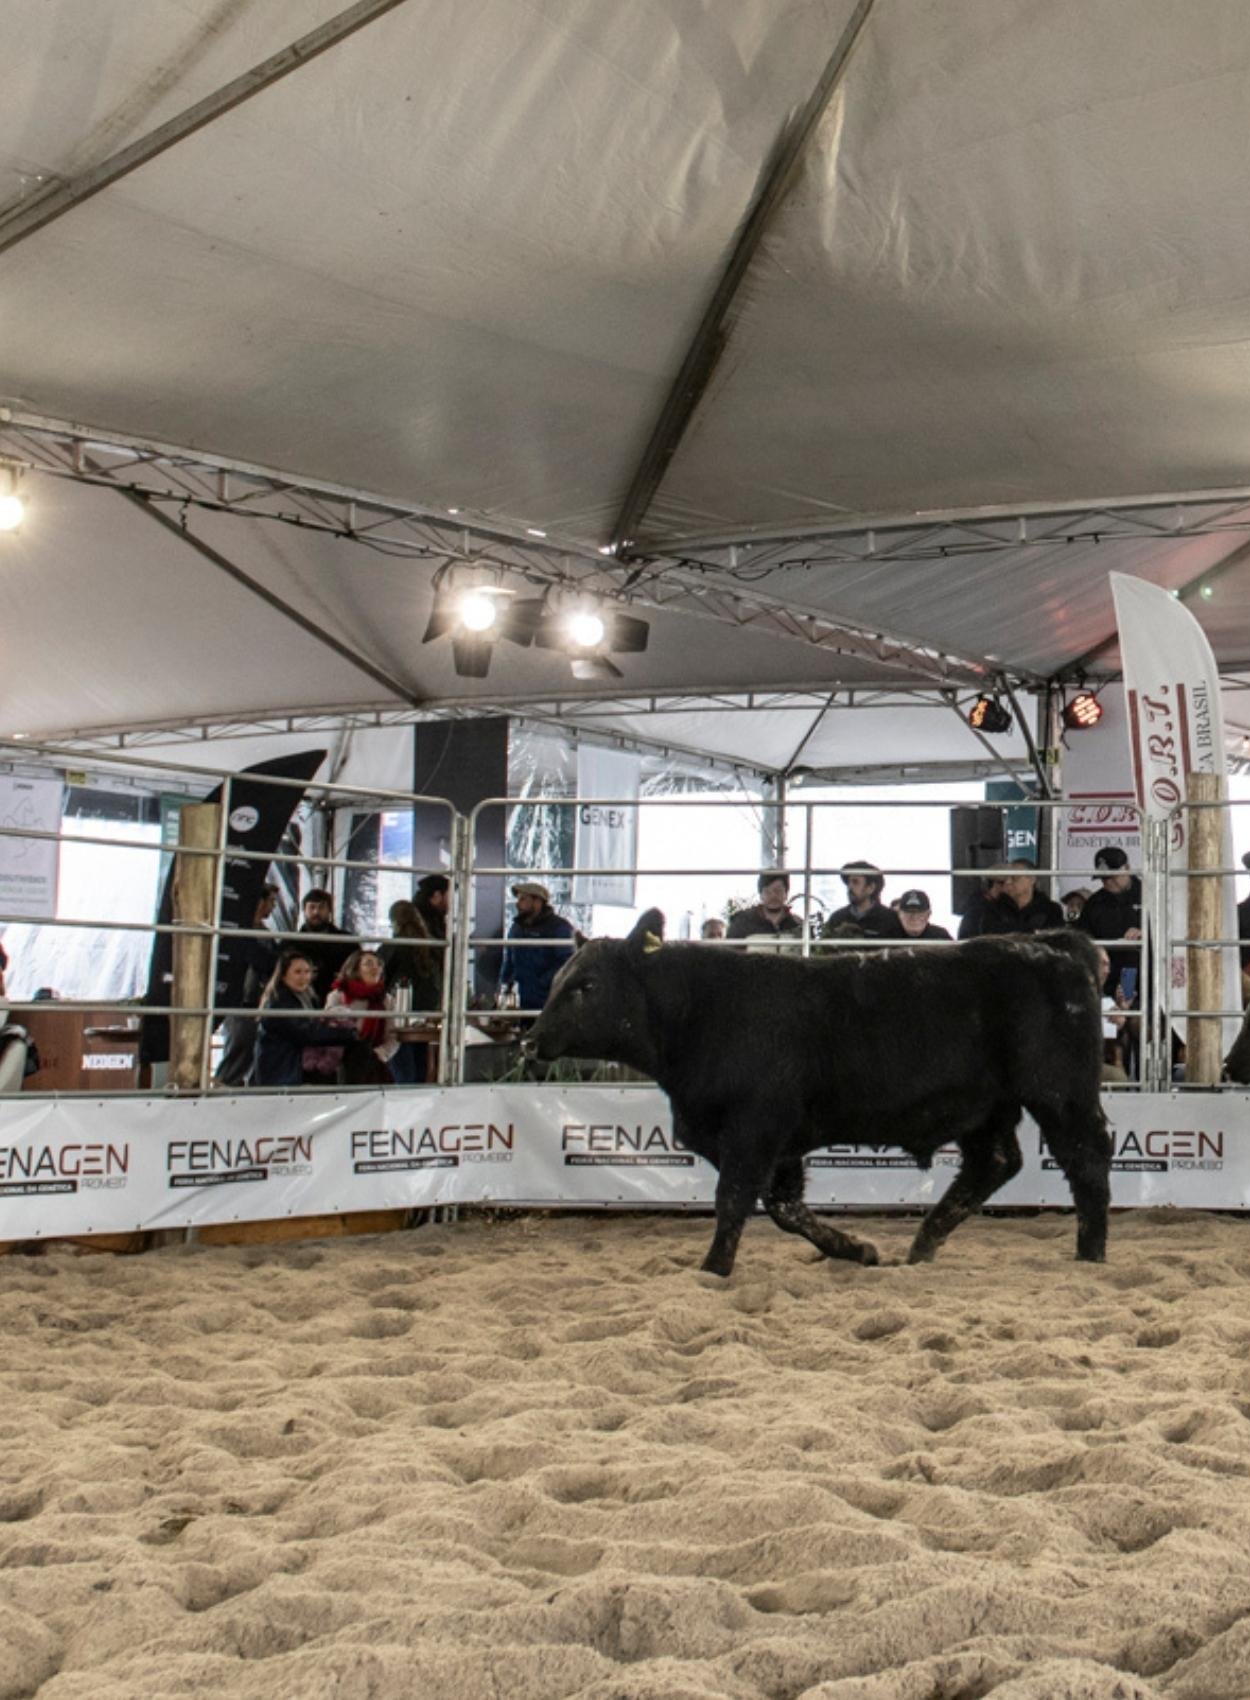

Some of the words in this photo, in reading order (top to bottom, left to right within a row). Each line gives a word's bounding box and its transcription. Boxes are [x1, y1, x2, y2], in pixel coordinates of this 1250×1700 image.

[1192, 680, 1213, 749] BRASIL
[581, 804, 626, 829] GENEX
[167, 1135, 314, 1171] FENAGEN
[350, 1123, 514, 1159] FENAGEN
[0, 1143, 129, 1178] NAGEN
